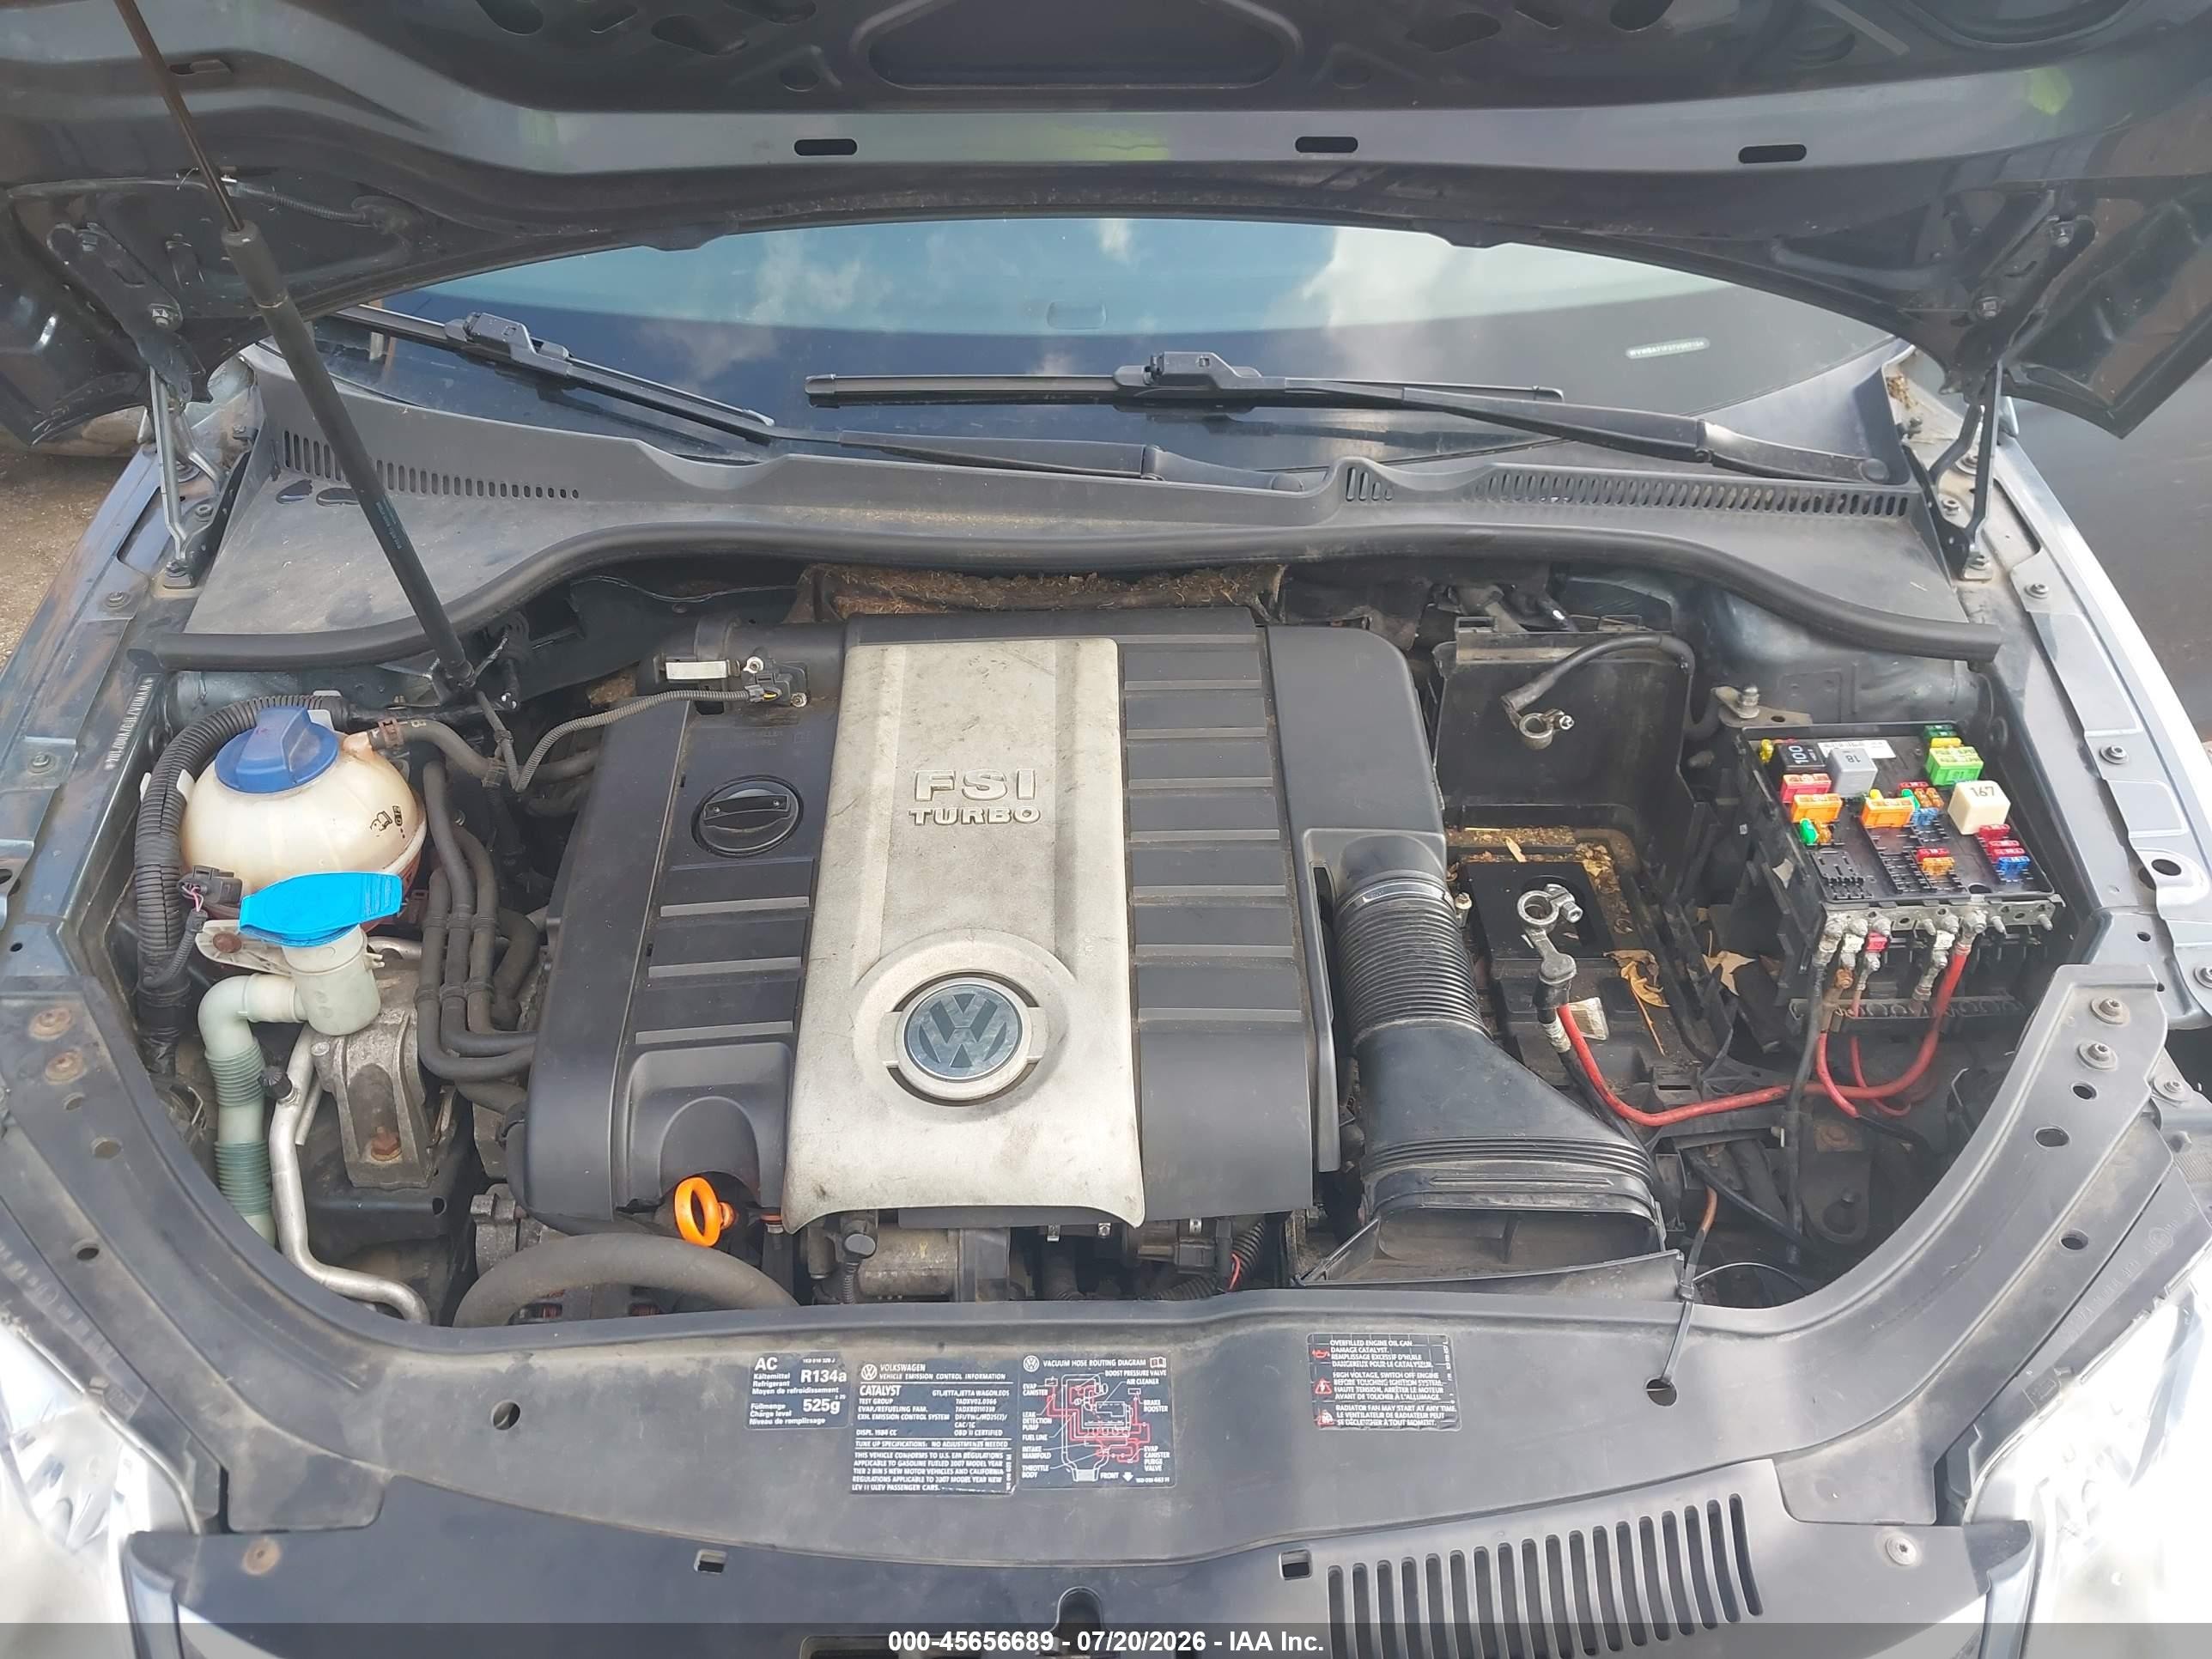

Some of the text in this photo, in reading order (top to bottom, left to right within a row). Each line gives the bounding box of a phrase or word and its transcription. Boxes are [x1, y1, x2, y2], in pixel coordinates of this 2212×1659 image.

[1788, 745, 1809, 764] 100
[914, 769, 1036, 802] FSI
[1970, 786, 1995, 798] 167
[908, 806, 1041, 826] TURBO
[755, 1357, 778, 1370] AC
[801, 1370, 848, 1383] R134a
[860, 1385, 902, 1396] CATALYST
[803, 1399, 841, 1414] 525g
